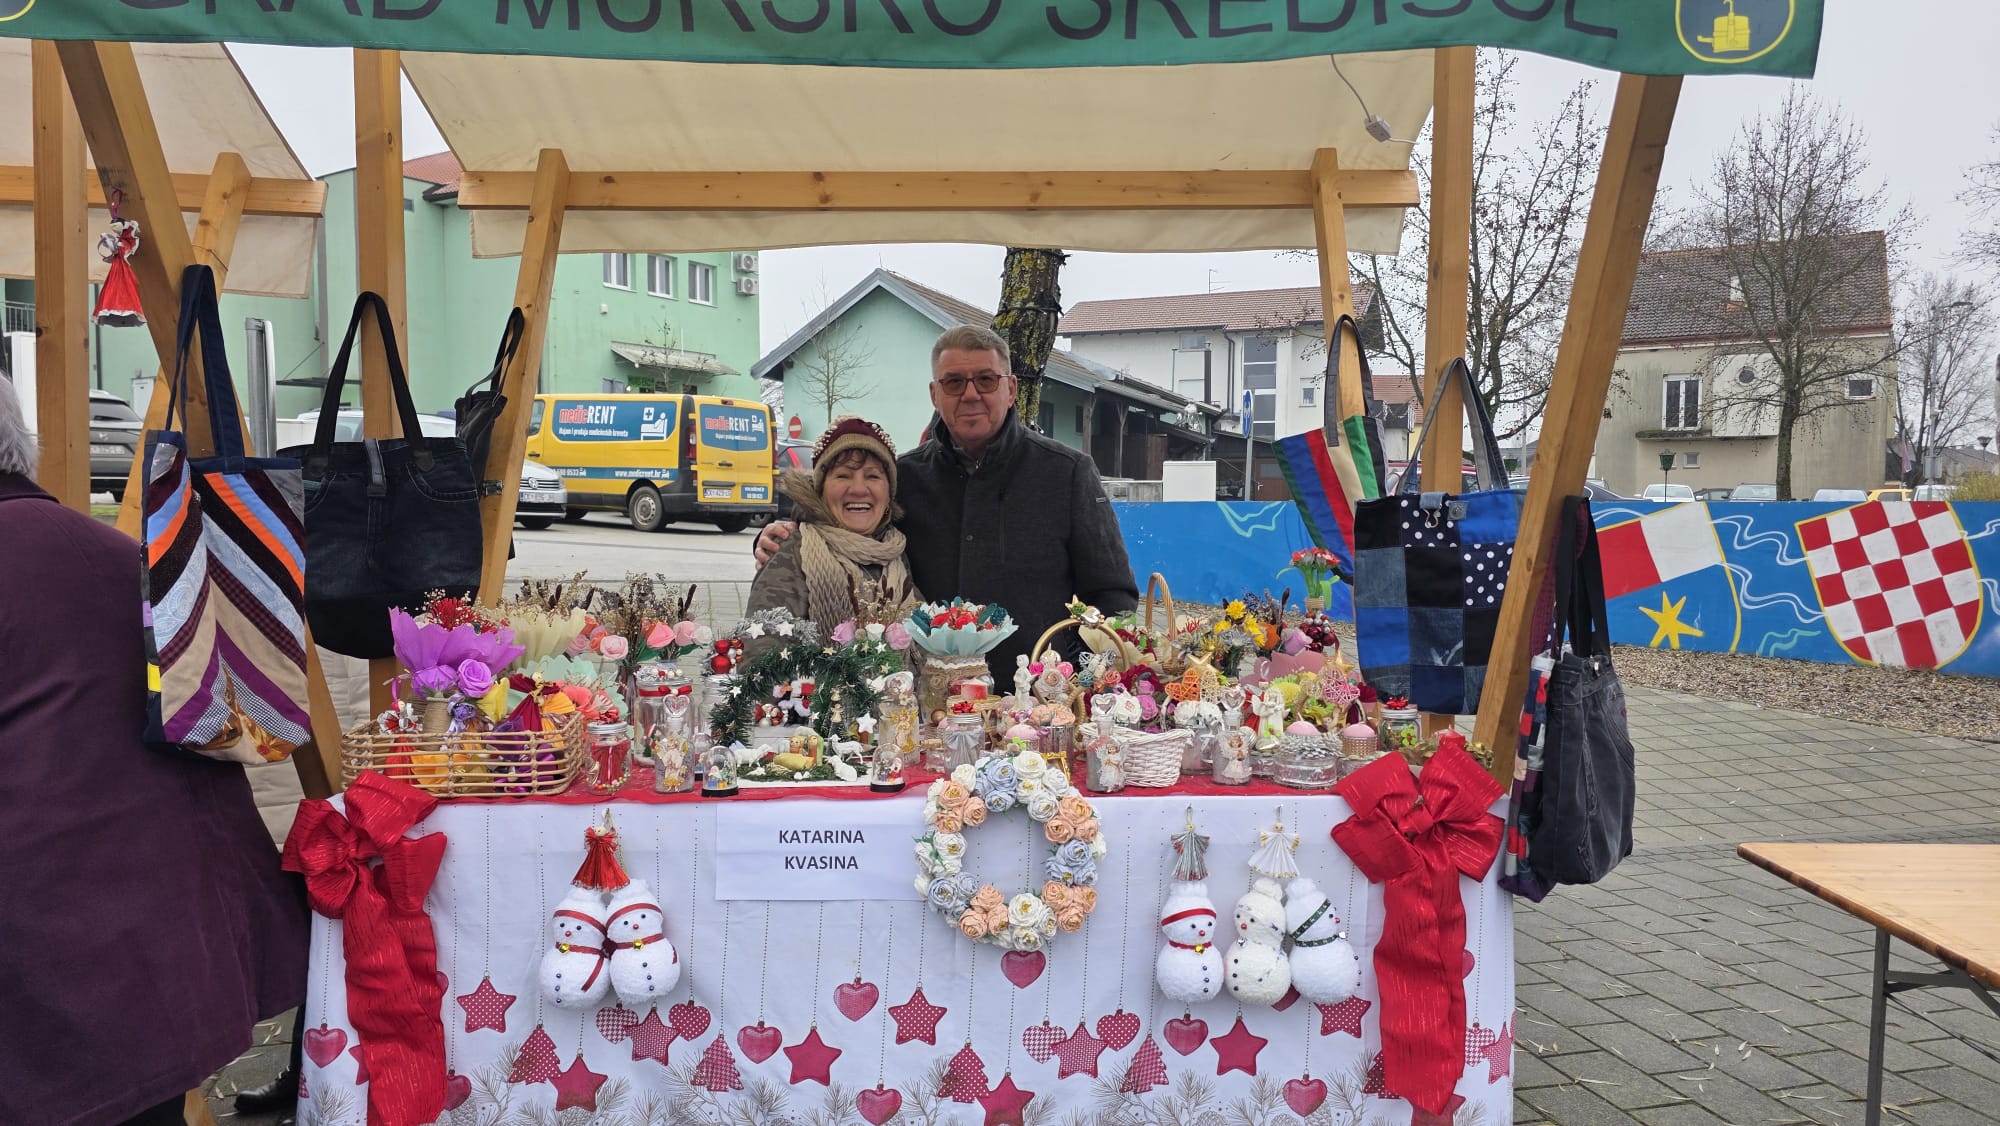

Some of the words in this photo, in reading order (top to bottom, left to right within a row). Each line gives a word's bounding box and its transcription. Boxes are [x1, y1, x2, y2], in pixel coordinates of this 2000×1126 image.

[559, 404, 617, 425] medicRENT
[779, 830, 865, 844] KATARINA
[785, 856, 859, 870] KVASINA
